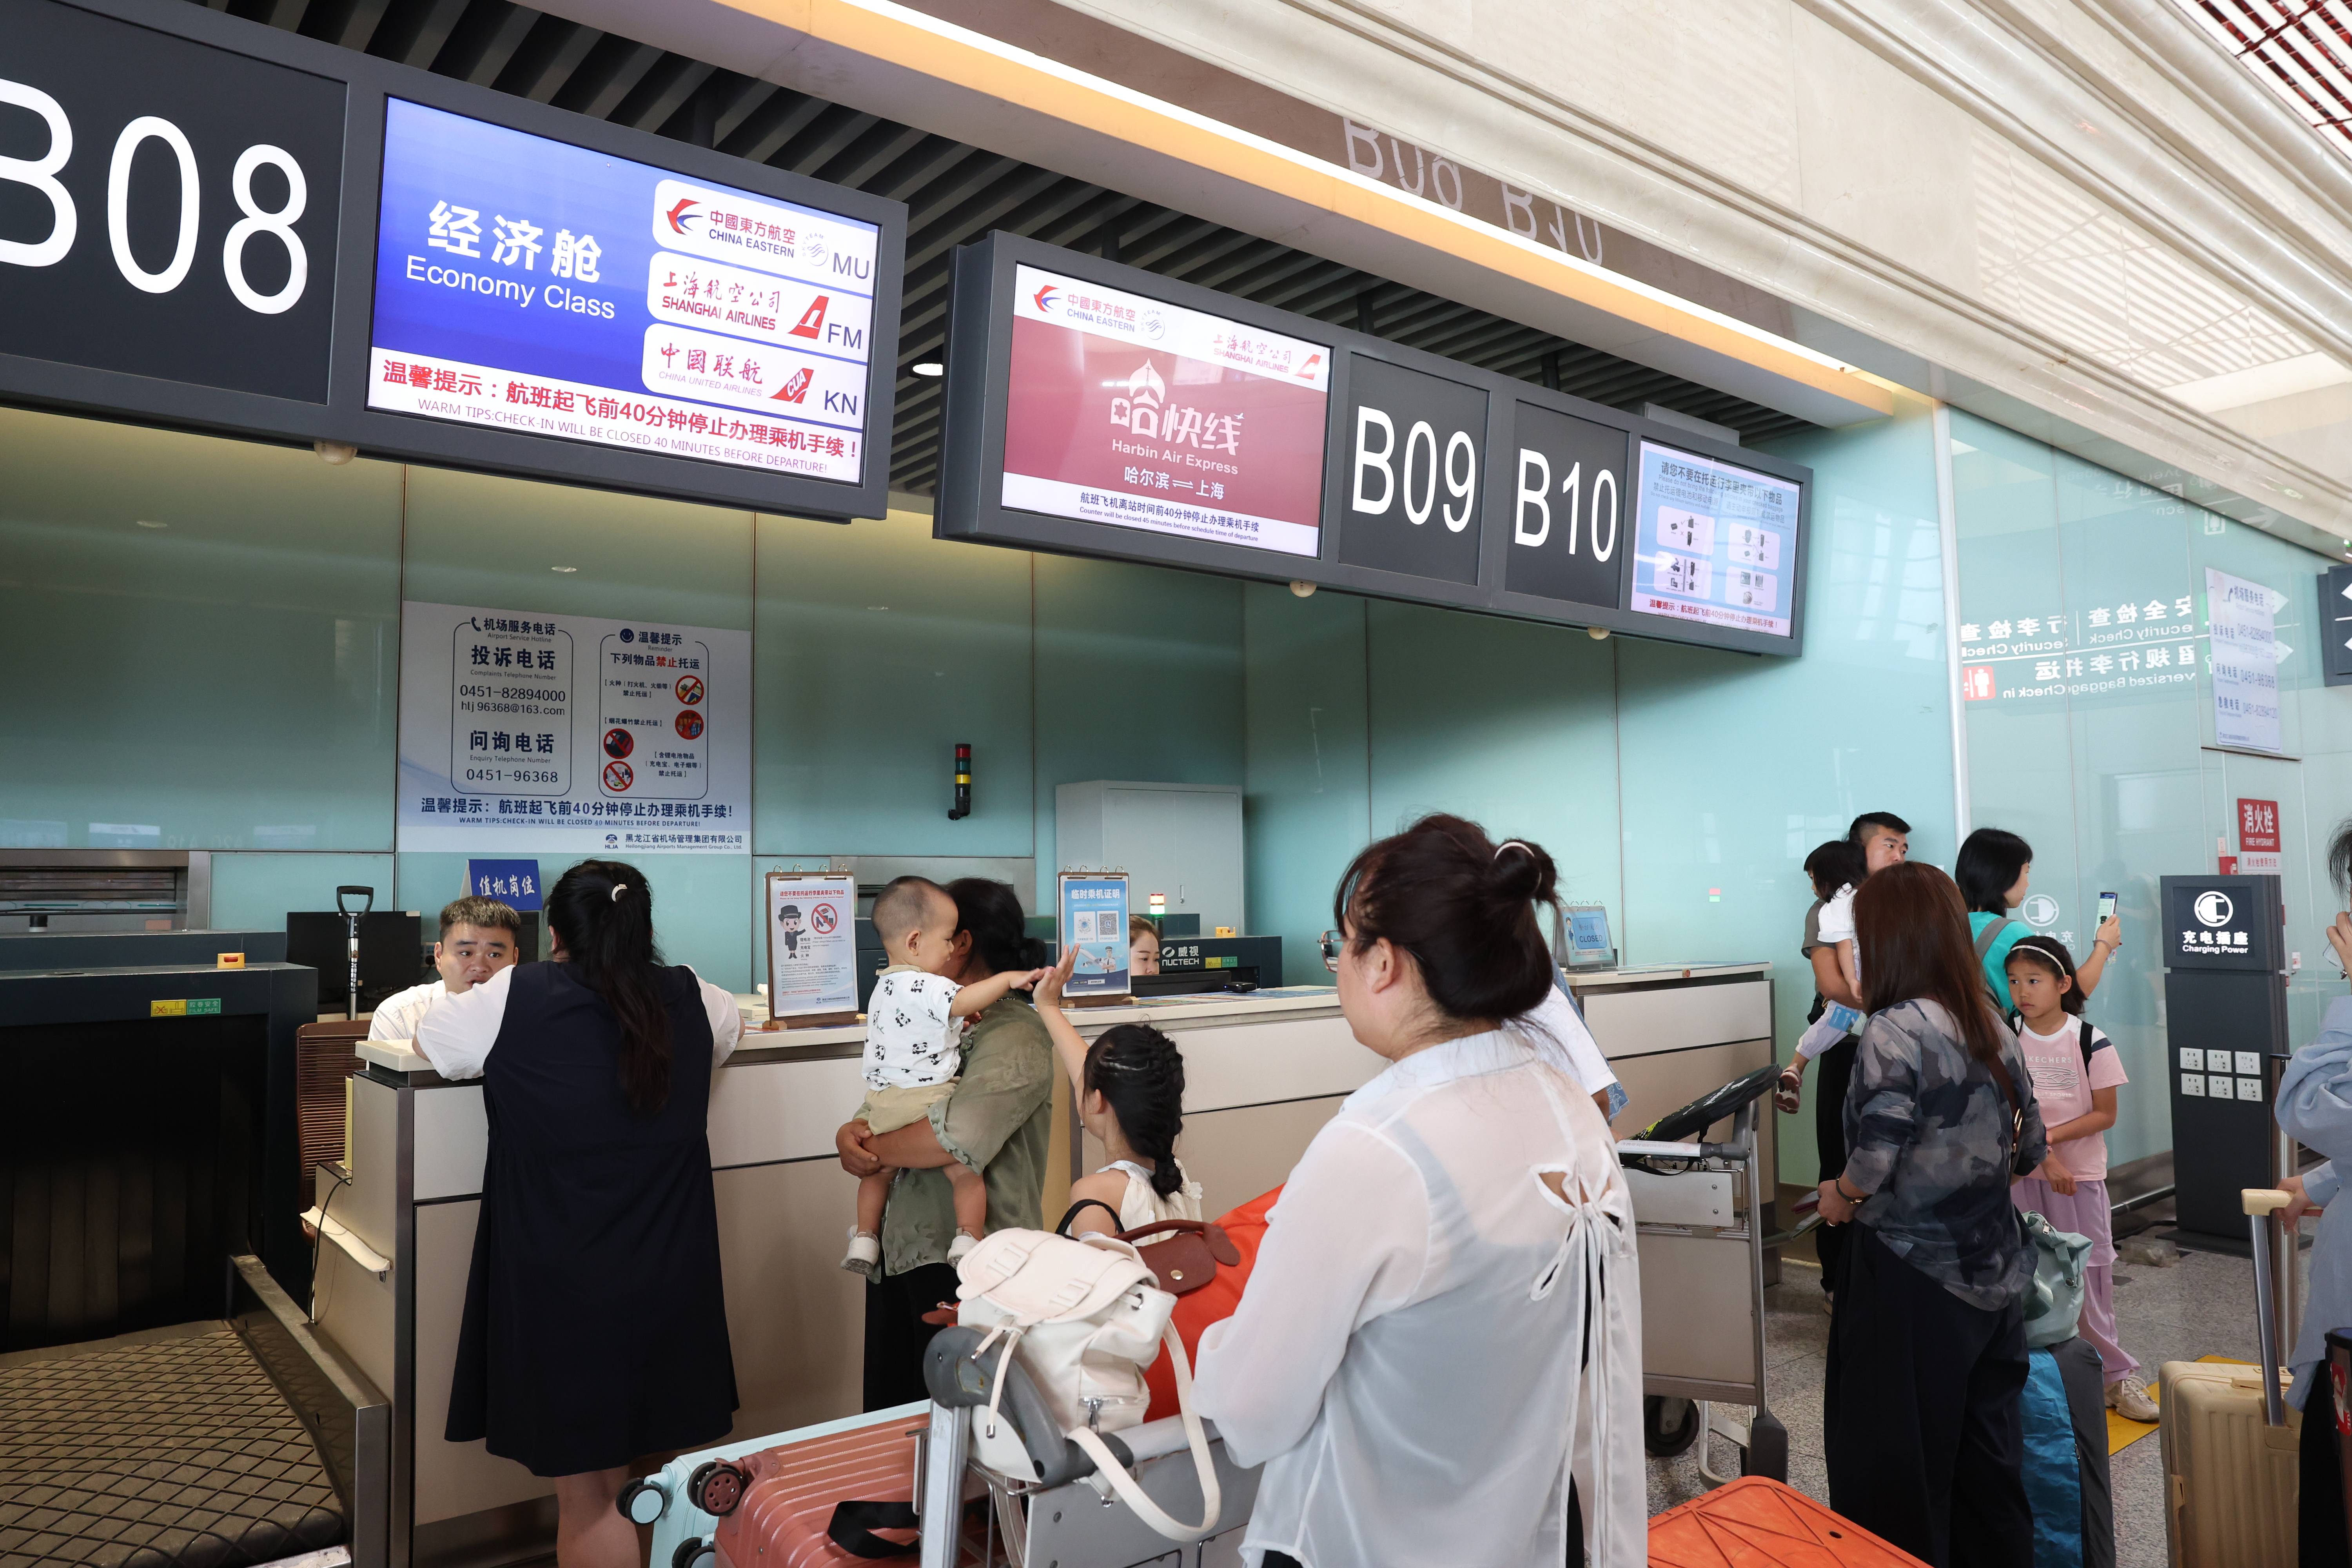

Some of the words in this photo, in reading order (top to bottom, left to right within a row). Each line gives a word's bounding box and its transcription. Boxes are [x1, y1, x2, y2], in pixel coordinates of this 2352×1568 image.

[0, 80, 307, 314] B08
[710, 211, 795, 244] 中國東方航空
[428, 200, 602, 283] 经济舱
[709, 229, 742, 245] CHINA
[746, 239, 794, 258] EASTERN
[833, 252, 869, 279] MU
[407, 255, 535, 307] Economy
[544, 285, 615, 318] Class
[663, 271, 780, 312] 上海航空公司
[662, 296, 722, 319] SHANGHAI
[726, 312, 775, 330] AIRLINES
[1067, 309, 1094, 322] CHINA
[1096, 316, 1135, 332] EASTERN
[1068, 294, 1136, 322] 中國東方航空
[828, 323, 862, 349] FM
[1214, 334, 1291, 363] 上海航空公司
[1214, 348, 1253, 364] SHANGHAI
[1256, 359, 1289, 373] AIRLINES
[659, 371, 686, 383] CHINA
[689, 377, 721, 389] UNITED
[723, 384, 762, 396] AIRLINES
[787, 370, 806, 396] CUA
[824, 390, 857, 415] KN
[1111, 359, 1243, 456] 哈快线
[418, 399, 461, 415] WARM
[558, 421, 586, 435] WILL
[590, 426, 603, 437] BE
[607, 429, 650, 445] CLOSED
[654, 436, 667, 447] 40
[671, 439, 720, 456] MINUTES
[724, 448, 763, 463] BEFORE
[767, 455, 827, 473] DEPARTURE!
[1112, 439, 1158, 459] Harbin
[1162, 449, 1182, 464] Air
[1186, 454, 1238, 475] Express
[1352, 405, 1476, 533] B09
[1124, 466, 1169, 490] 哈尔滨
[1196, 478, 1225, 500] 上海
[1659, 474, 1672, 483] Please
[1662, 461, 1782, 505] 请您不要在托运行李里夹带以下物品
[1515, 448, 1617, 562] B10
[1080, 506, 1102, 518] Counter
[1104, 509, 1114, 519] will
[1115, 511, 1122, 520] be
[1123, 512, 1141, 523] closed
[1151, 517, 1172, 527] minutes
[1173, 521, 1191, 531] before
[1192, 523, 1214, 534] schedule
[1216, 526, 1226, 536] time
[1227, 529, 1234, 537] of
[1234, 530, 1258, 542] departure
[484, 617, 556, 635] 机场服务电话
[639, 631, 682, 646] 温馨提示
[472, 644, 555, 670] 投诉电话
[610, 653, 700, 669] 下列物品禁止托运
[460, 684, 566, 702] 0451-82894000
[470, 730, 554, 753] 问询电话
[466, 769, 558, 783] 0451-96368
[2244, 804, 2274, 833] 消火栓
[625, 834, 742, 844] 黑龙江省机场管理集团有限公司
[480, 875, 535, 897] 值机岗位
[1071, 889, 1120, 899] 临时乘机证明
[2182, 930, 2249, 945] 充电插座
[2182, 945, 2220, 954] Charging
[1178, 946, 1199, 957] 威视
